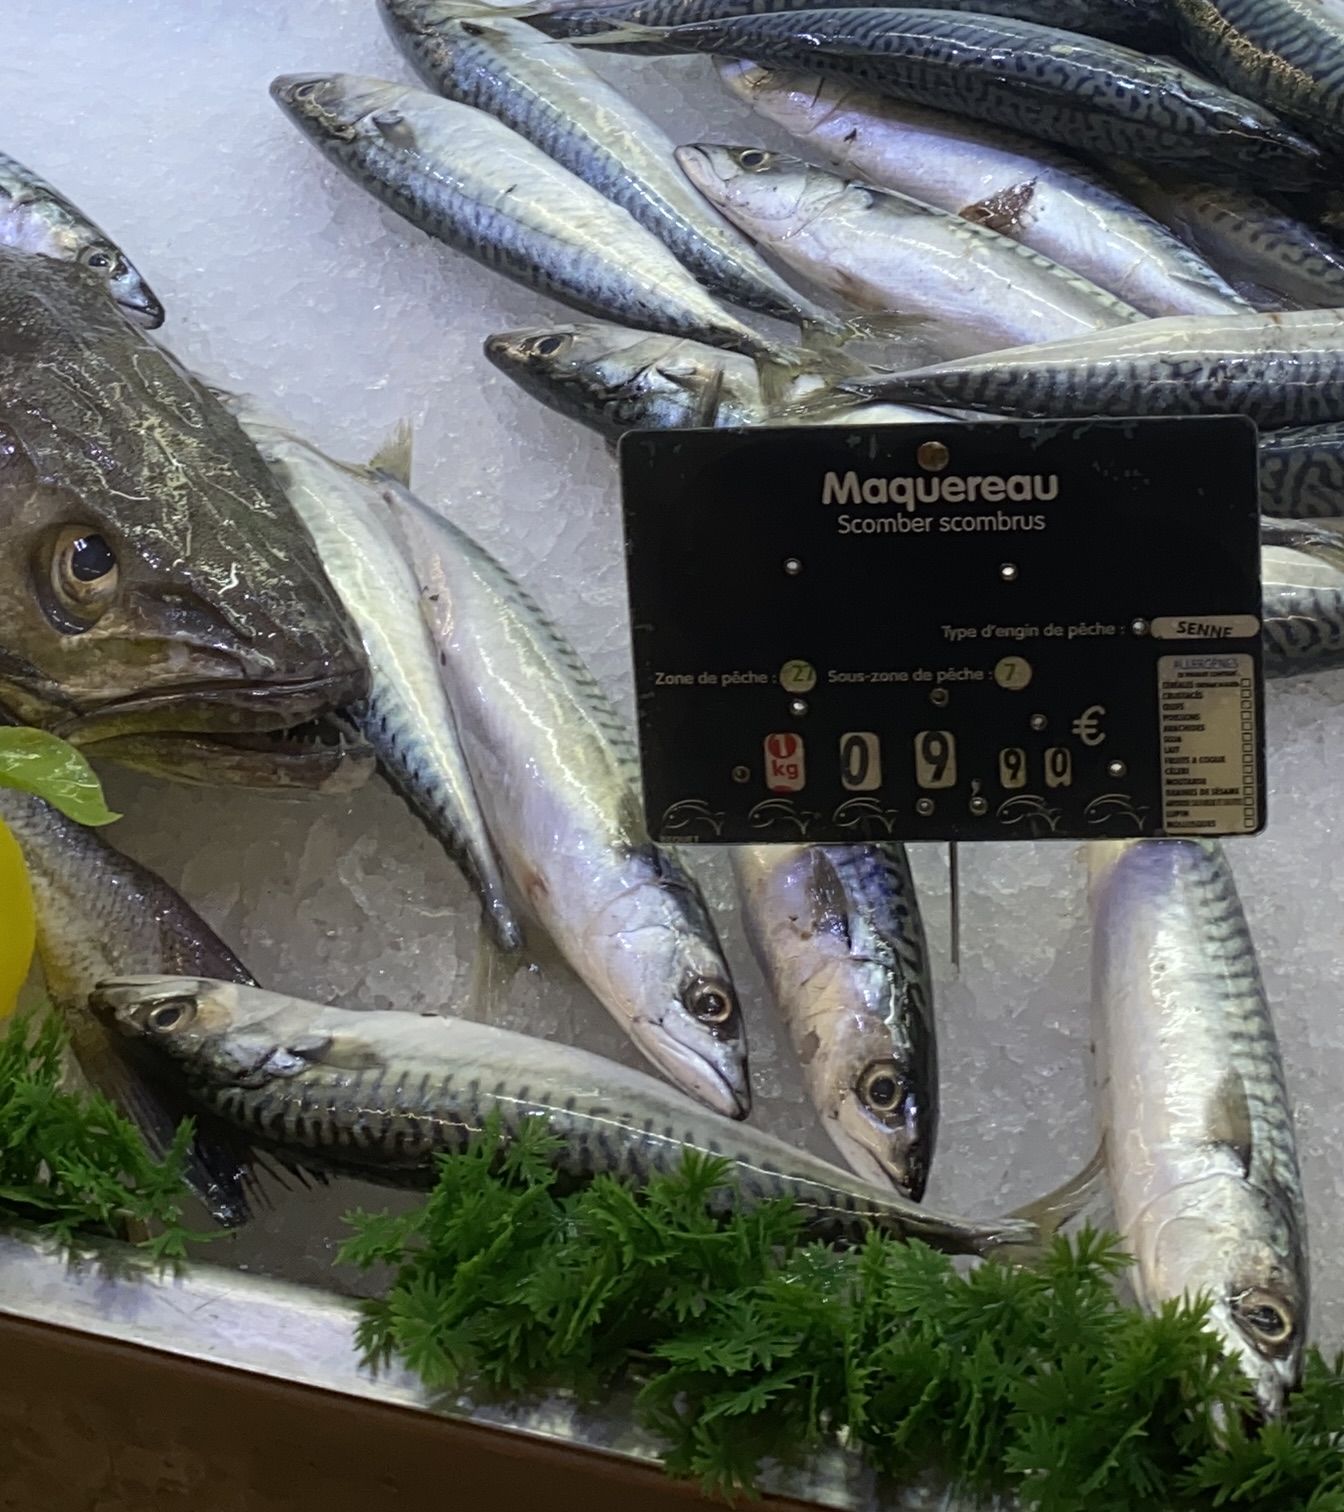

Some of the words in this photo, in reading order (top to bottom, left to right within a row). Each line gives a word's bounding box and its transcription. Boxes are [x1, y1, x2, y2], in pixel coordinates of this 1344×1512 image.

[821, 468, 1060, 514] Maquereau
[837, 514, 932, 535] Scomber
[938, 511, 1047, 533] scombrus
[941, 623, 977, 641] Type
[981, 622, 1040, 640] d'engin
[1043, 622, 1063, 637] de
[1067, 621, 1117, 640] pêche
[1175, 621, 1235, 639] SENNE
[654, 670, 693, 686] Zone
[695, 670, 718, 686] de
[720, 669, 771, 688] pêche
[790, 662, 815, 684] 27
[827, 667, 908, 685] Sous-zone
[911, 667, 932, 683] de
[934, 667, 985, 686] pêche
[1003, 663, 1017, 680] 7
[1069, 705, 1107, 748] €
[771, 759, 798, 781] kg
